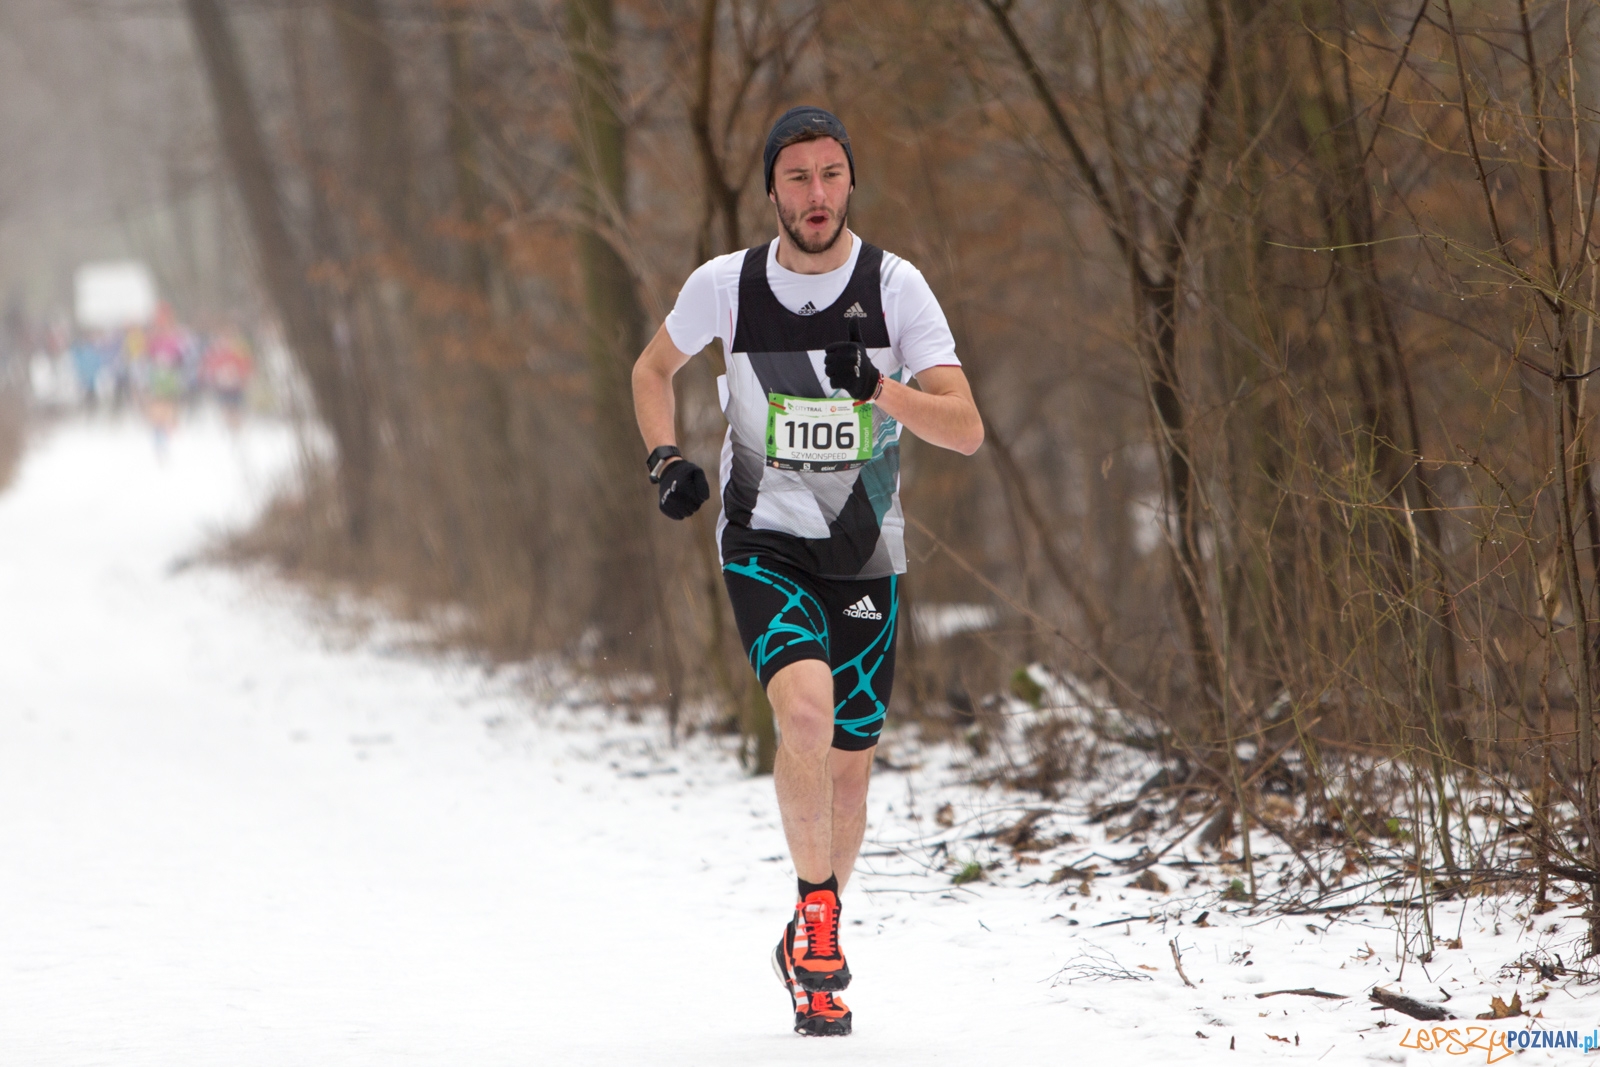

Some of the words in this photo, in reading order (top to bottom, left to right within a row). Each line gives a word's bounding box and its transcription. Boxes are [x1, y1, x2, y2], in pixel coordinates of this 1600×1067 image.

[784, 420, 854, 450] 1106
[791, 451, 847, 460] SZYMONSPEED
[842, 608, 882, 620] adidas
